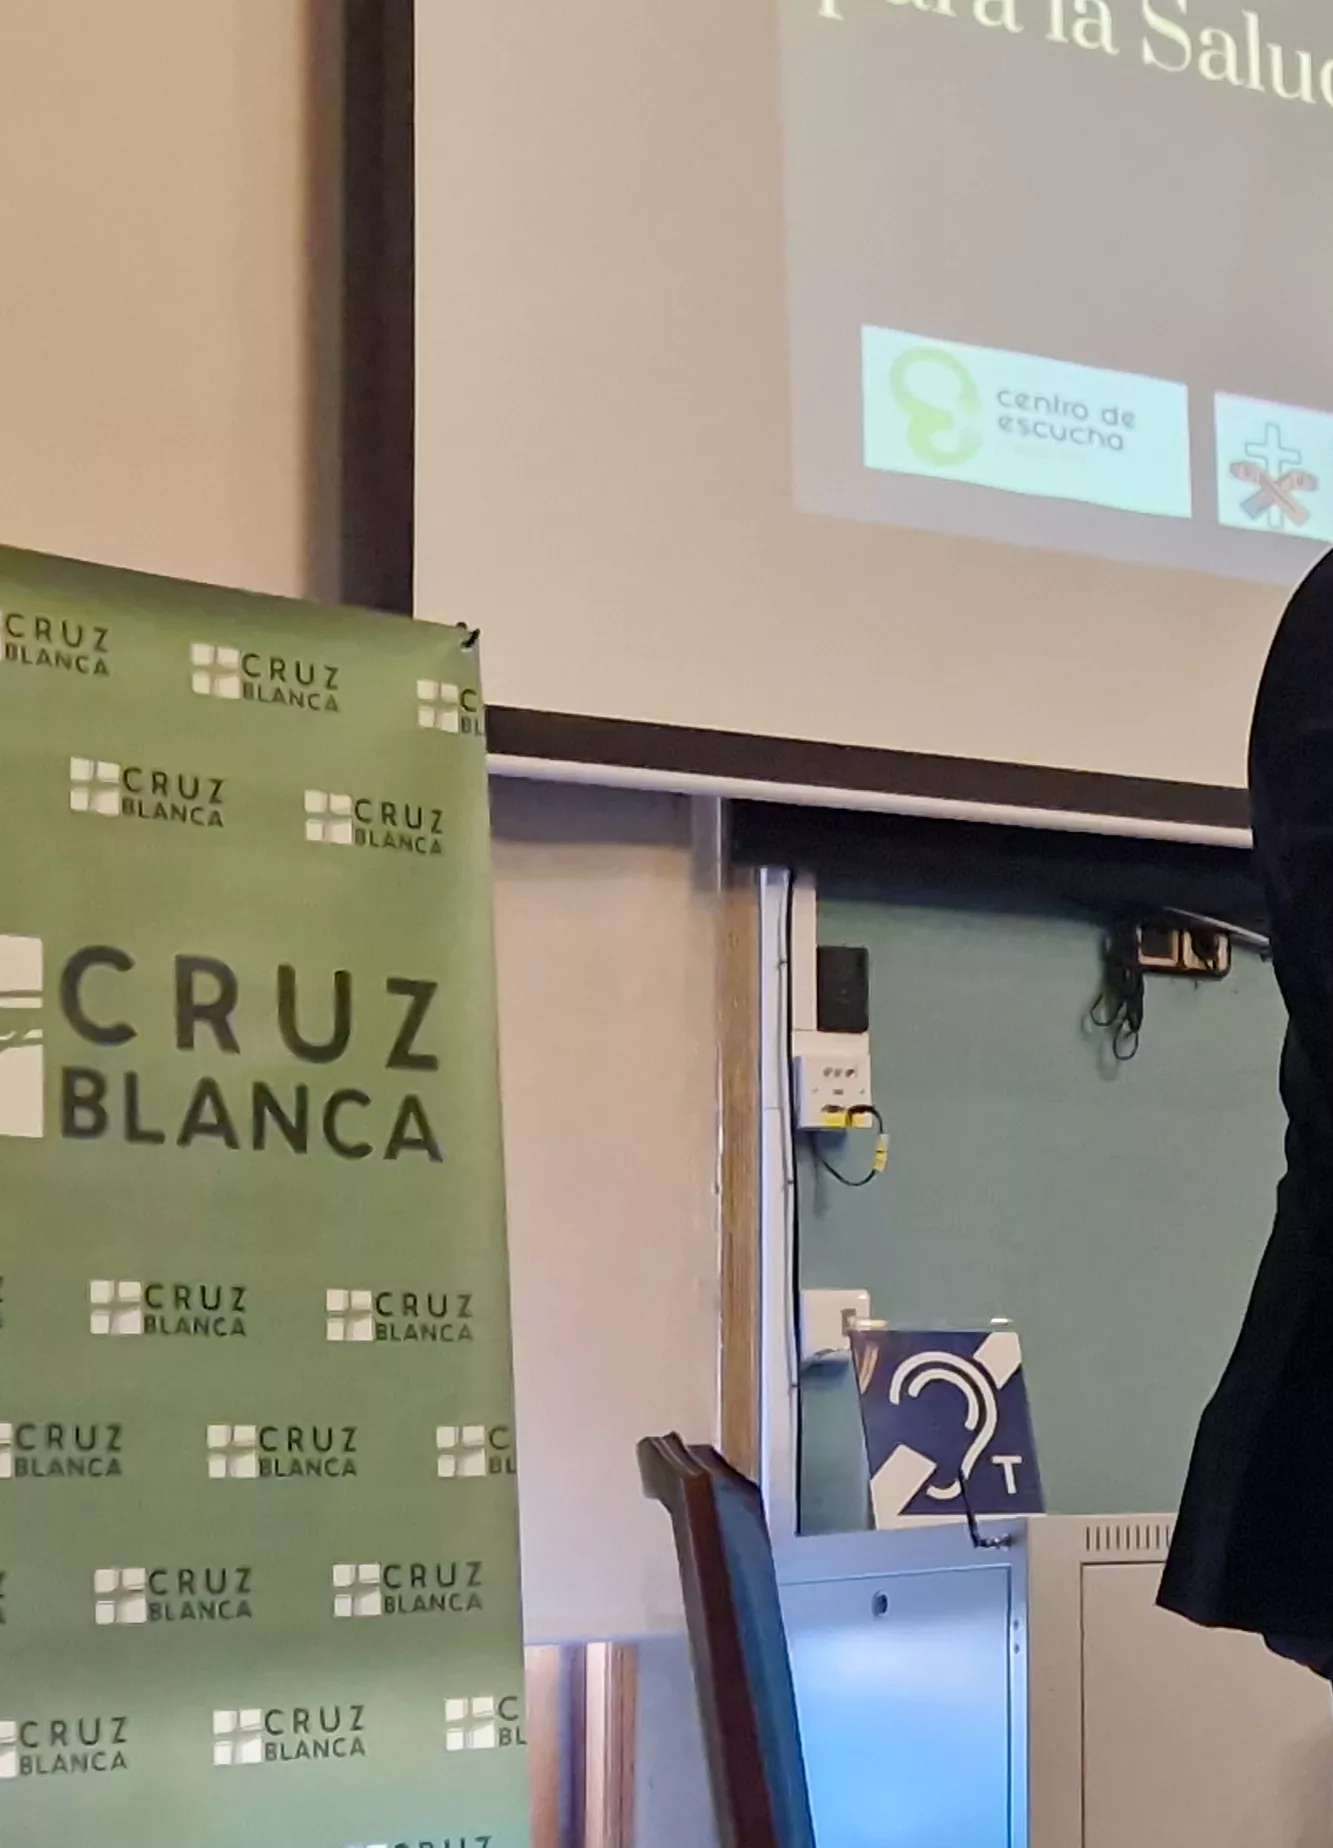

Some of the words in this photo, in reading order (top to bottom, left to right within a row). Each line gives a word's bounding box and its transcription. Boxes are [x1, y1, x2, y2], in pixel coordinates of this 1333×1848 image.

[1101, 404, 1136, 430] de
[998, 415, 1124, 451] escucha
[5, 612, 109, 654] CRUZ
[5, 642, 110, 678] BLANCA
[242, 653, 340, 690] CRUZ
[242, 681, 340, 713] BLANCA
[122, 766, 225, 803] CRUZ
[122, 798, 225, 829] BLANCA
[354, 799, 444, 835] CRUZ
[354, 827, 444, 856] BLANCA
[59, 944, 440, 1072] CRUZ
[60, 1065, 444, 1163] BLANCA
[144, 1284, 247, 1313] CRUZ
[375, 1292, 474, 1320] CRUZ
[144, 1315, 247, 1338] BLANCA
[375, 1322, 474, 1343] BLANCA
[15, 1423, 123, 1452] CRUZ
[259, 1426, 358, 1454] CRUZ
[14, 1457, 123, 1478] BLANCA
[259, 1457, 358, 1478] BLANCA
[993, 1454, 1022, 1493] T
[148, 1567, 252, 1596] CRUZ
[383, 1561, 483, 1590] CRUZ
[148, 1599, 252, 1622] BLANCA
[383, 1592, 484, 1615] BLANCA
[19, 1716, 128, 1749] CRUZ
[263, 1704, 365, 1736] CRUZ
[19, 1751, 128, 1776] BLANCA
[264, 1737, 366, 1762] BLANCA
